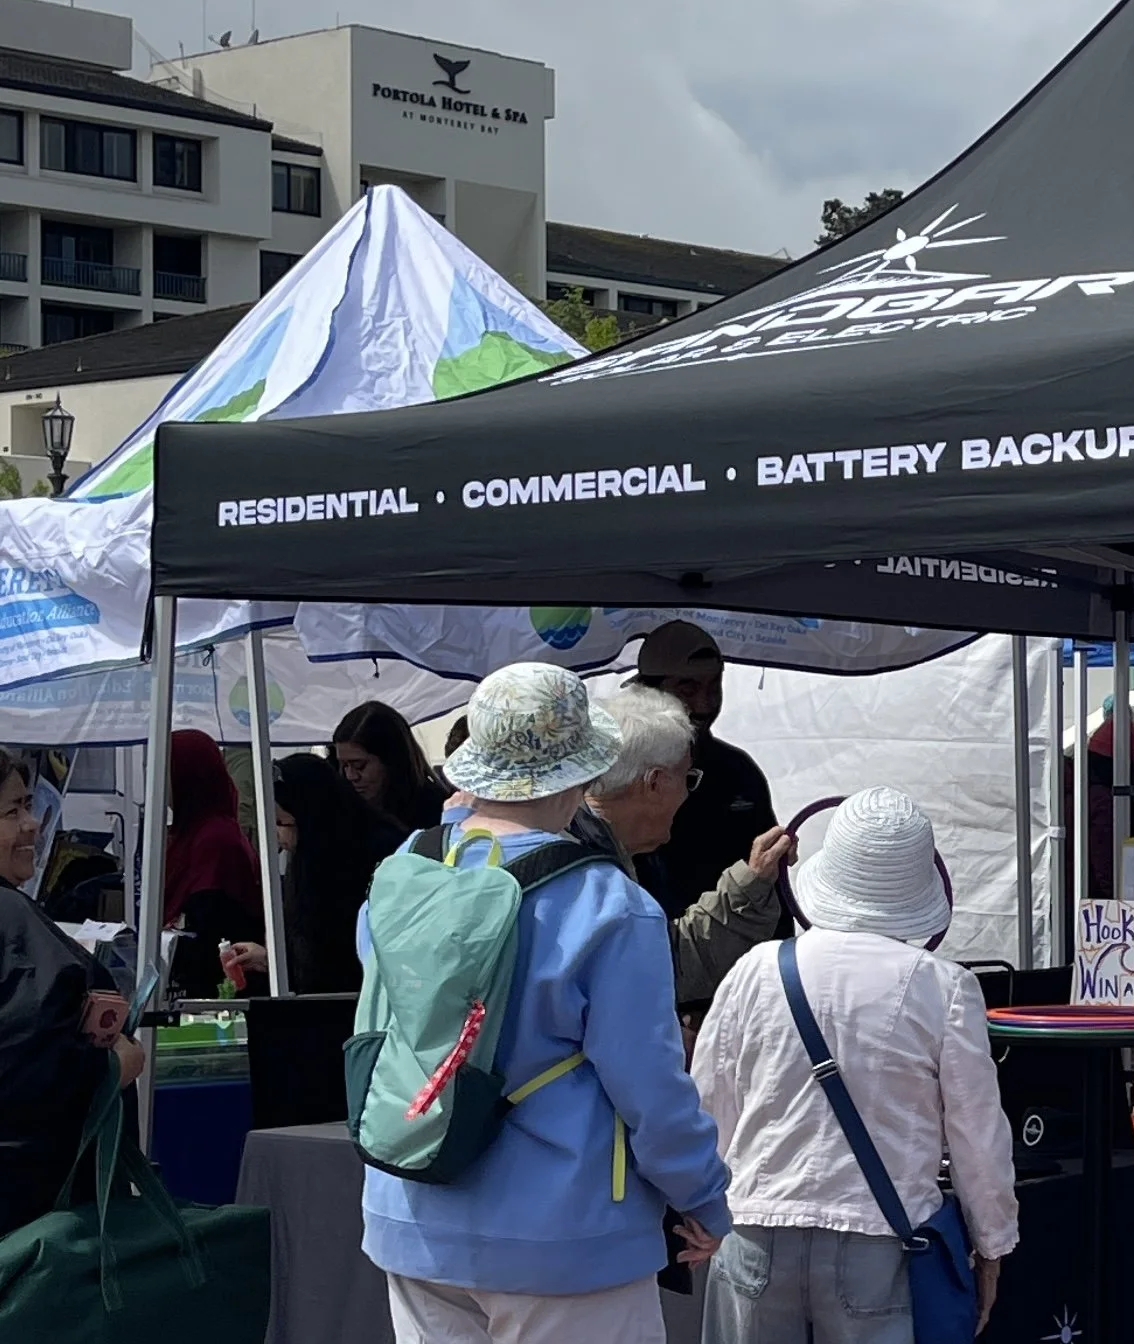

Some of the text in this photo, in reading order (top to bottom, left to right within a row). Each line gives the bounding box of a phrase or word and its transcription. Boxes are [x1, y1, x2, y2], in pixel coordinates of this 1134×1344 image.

[372, 83, 528, 124] PORTOLA HOTEL & SPA
[402, 110, 499, 136] AT MONTEREY BAY
[764, 306, 1037, 347] ELECTRIC
[217, 488, 419, 527] RESIDENTIAL
[462, 462, 706, 509] COMMERCIAL
[757, 442, 947, 486] BATTERY
[696, 610, 747, 628] Monterey
[726, 629, 747, 642] City
[1079, 955, 1119, 1000] WIN
